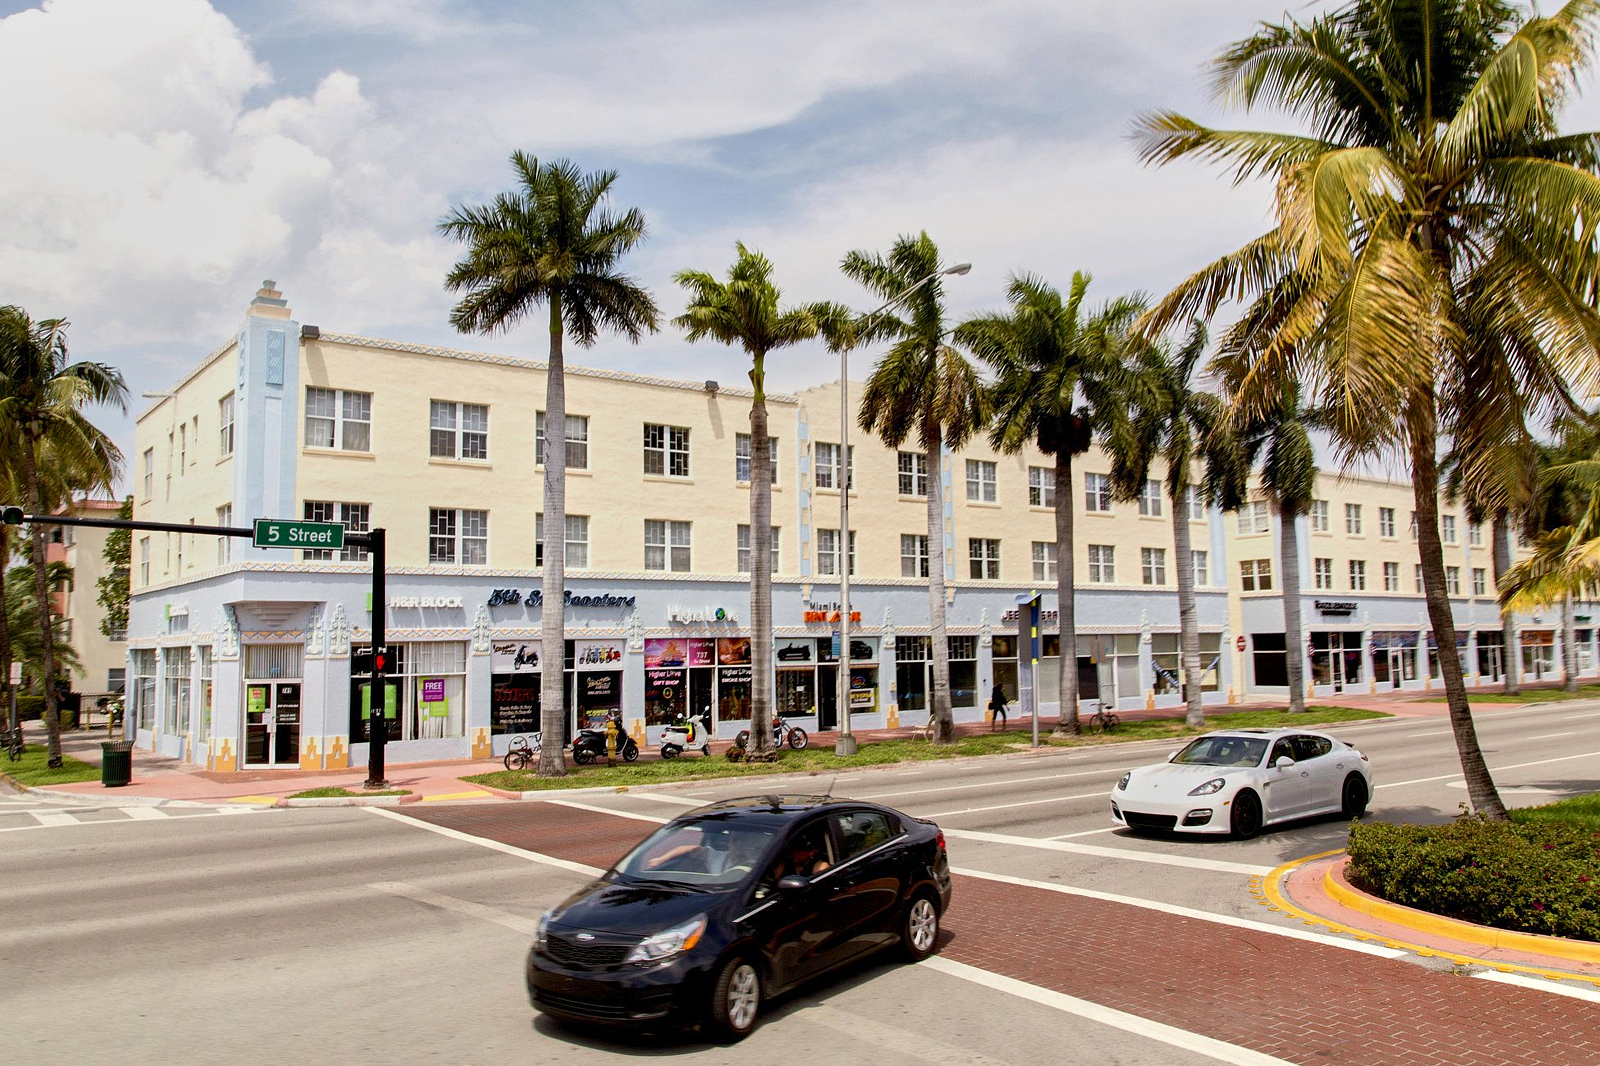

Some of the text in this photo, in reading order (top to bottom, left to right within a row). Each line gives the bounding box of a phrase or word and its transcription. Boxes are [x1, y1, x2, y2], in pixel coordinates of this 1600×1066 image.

[268, 526, 332, 543] 5 Street
[390, 596, 463, 608] H&R BLOCK
[487, 589, 522, 607] 5th
[525, 590, 543, 607] S
[810, 602, 853, 612] Miami Beh
[803, 611, 829, 623] RENT
[696, 651, 708, 659] 737
[425, 681, 443, 690] FREE
